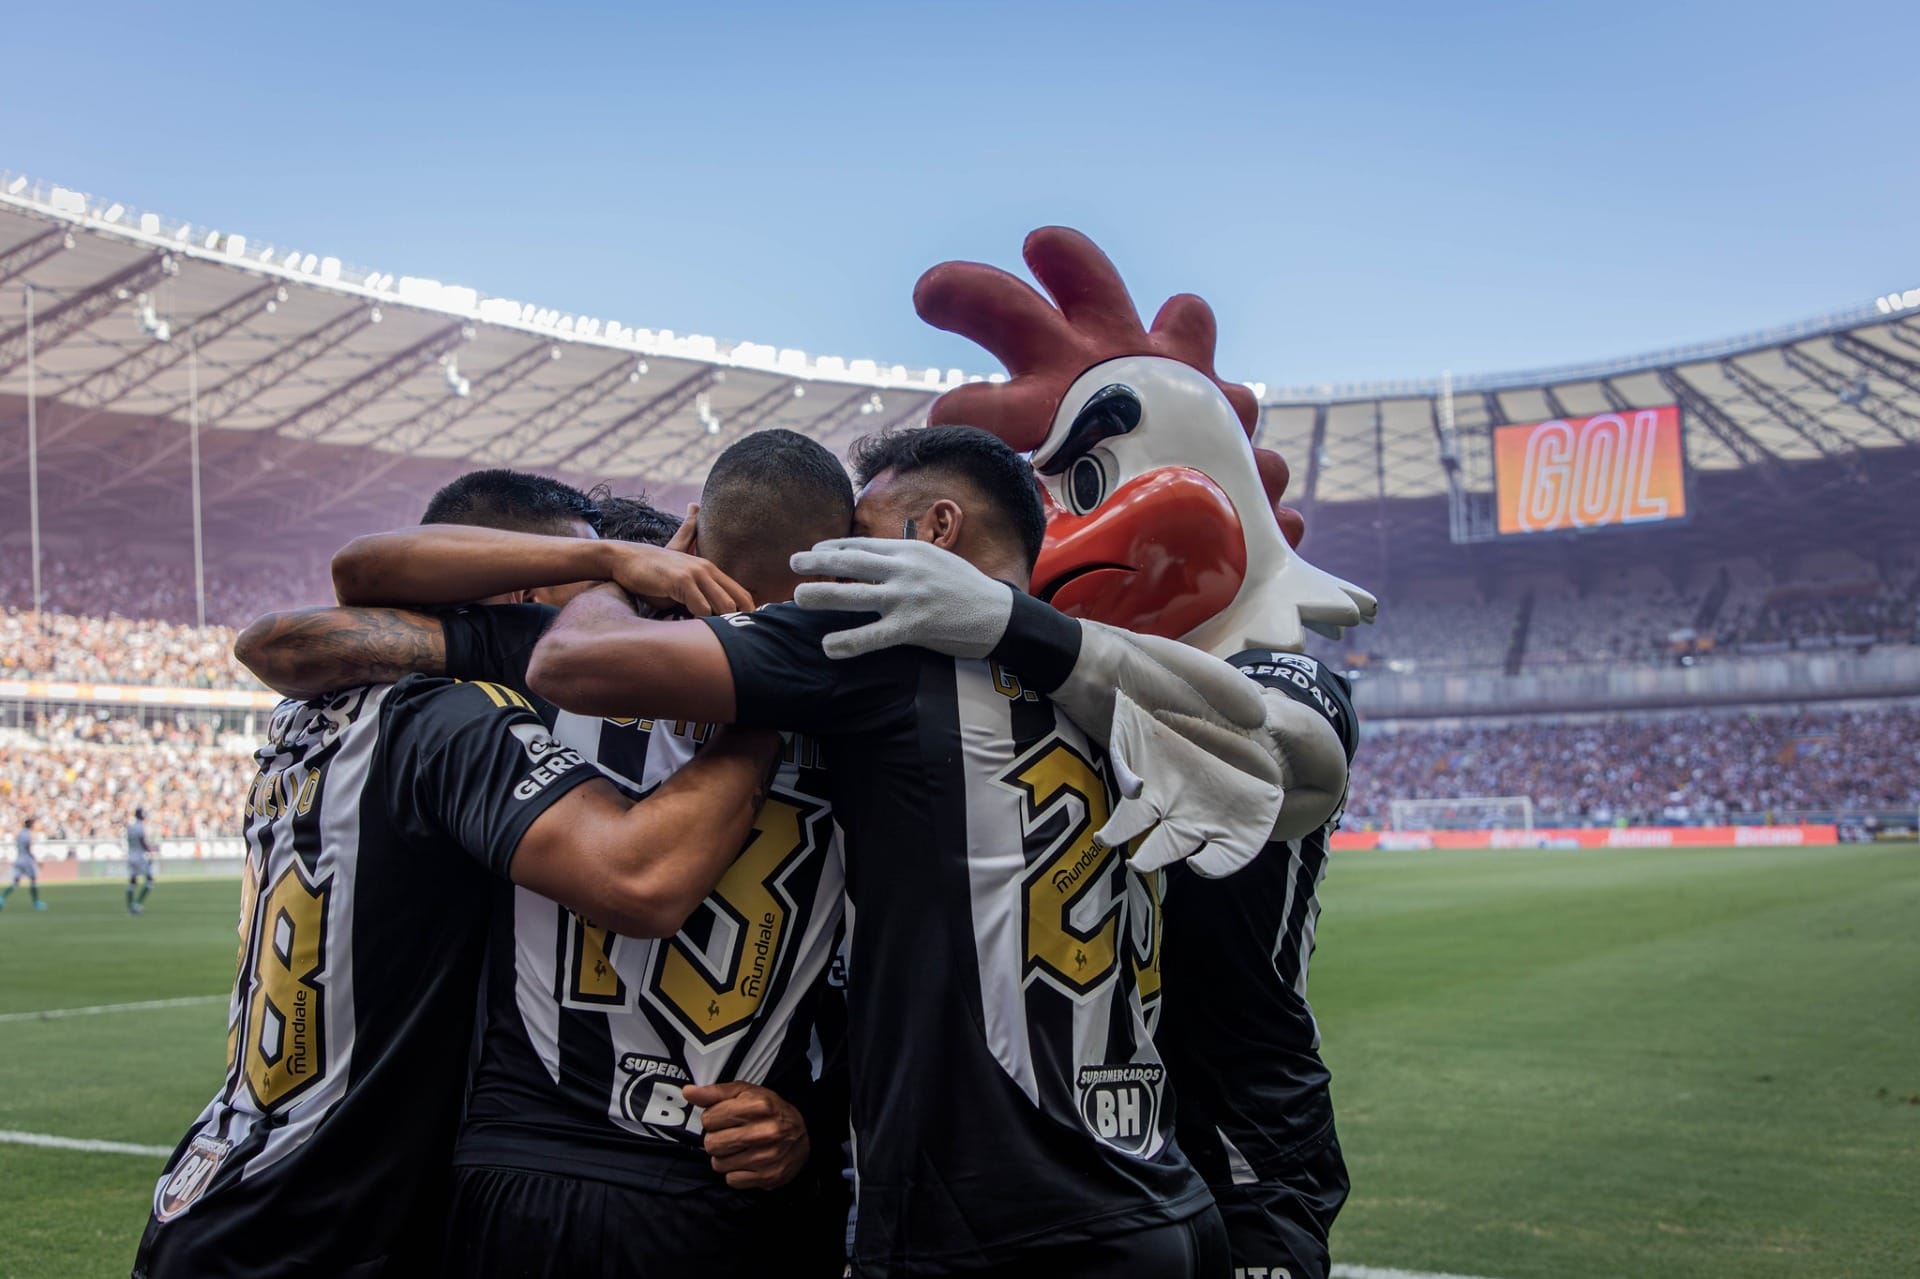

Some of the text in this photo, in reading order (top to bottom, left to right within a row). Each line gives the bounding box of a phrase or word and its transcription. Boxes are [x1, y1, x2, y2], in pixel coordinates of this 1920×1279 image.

[1517, 410, 1669, 534] GOL
[1239, 665, 1339, 718] GERDAU
[1052, 839, 1104, 894] mundial
[743, 912, 776, 998] mundiale
[288, 990, 307, 1076] mundiale
[1080, 1068, 1160, 1085] SUPERMERCADOS
[1096, 1088, 1141, 1138] BH
[166, 1155, 214, 1201] BH
